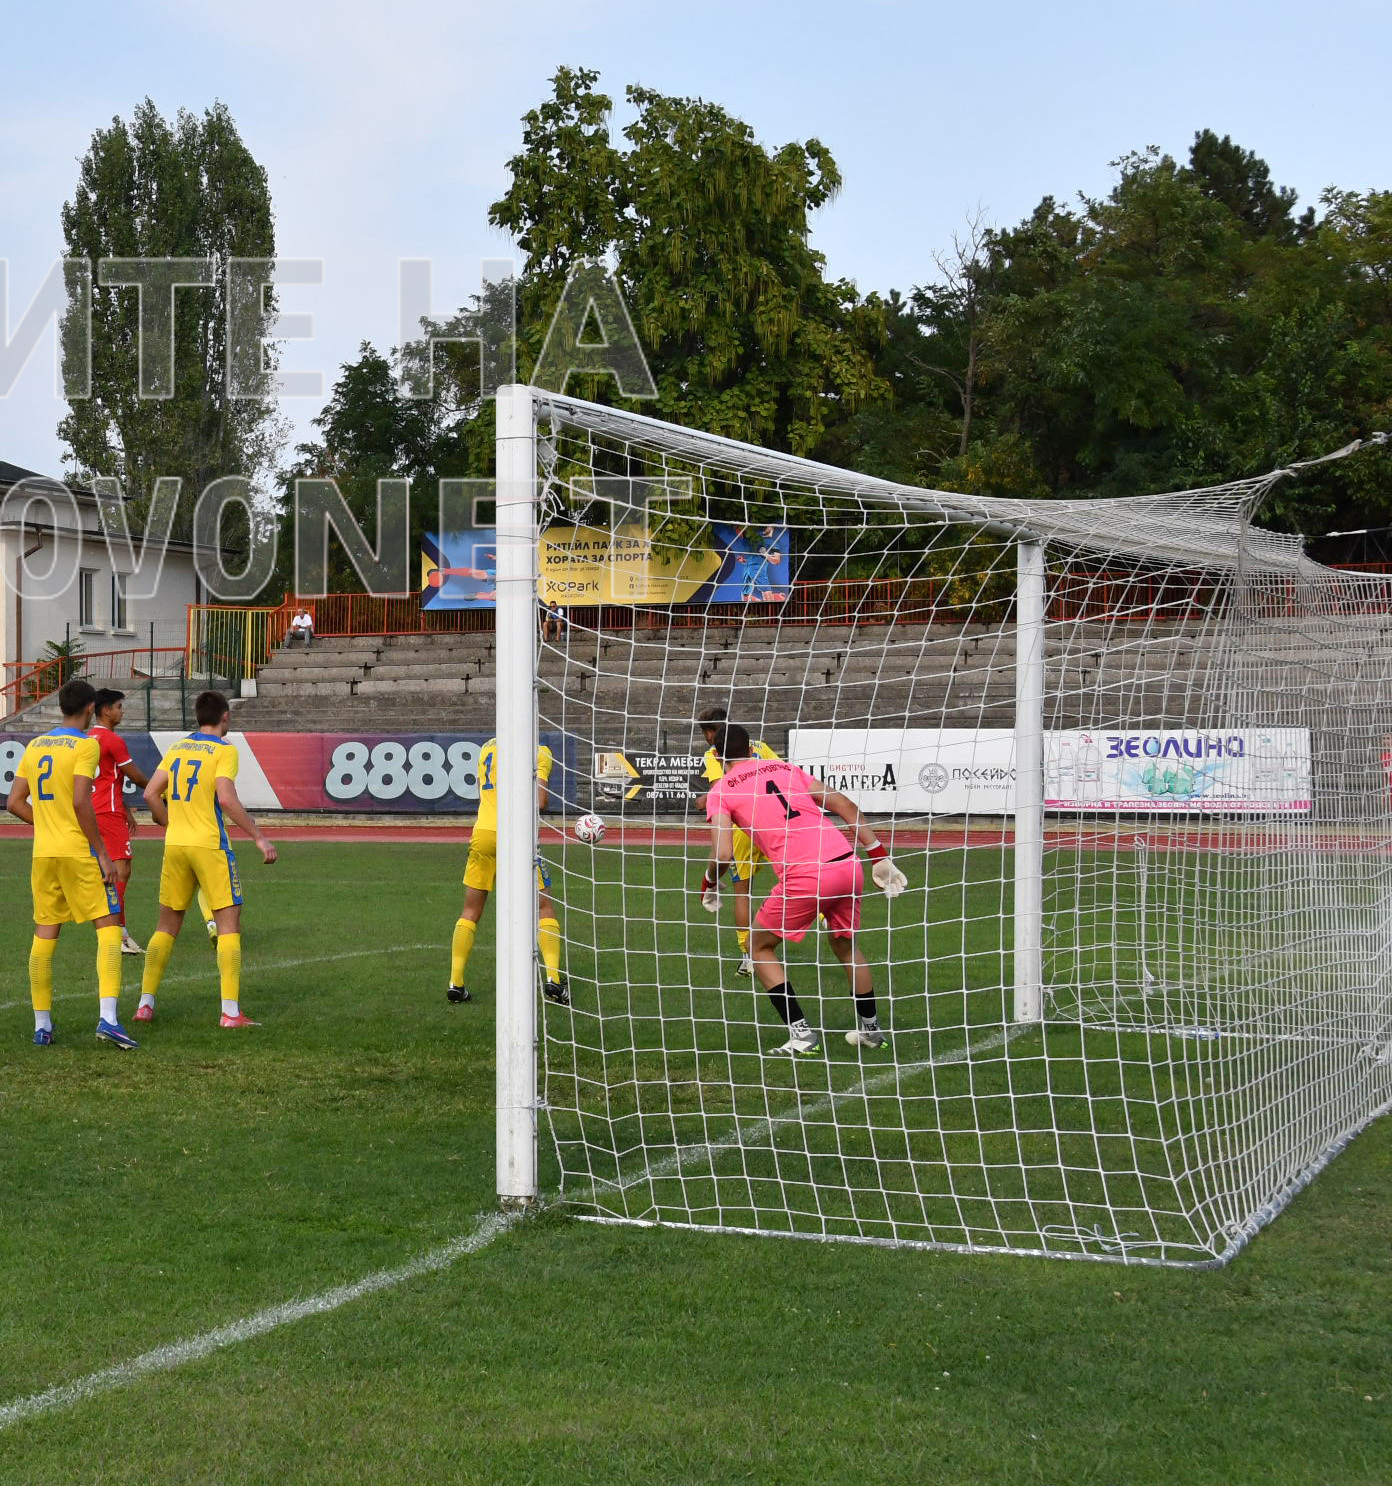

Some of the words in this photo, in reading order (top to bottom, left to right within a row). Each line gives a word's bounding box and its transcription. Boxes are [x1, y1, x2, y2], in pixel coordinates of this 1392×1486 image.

[546, 540, 590, 552] РИТЕЙЛ
[625, 540, 640, 549] ЗА
[546, 554, 589, 565] ХОРАТА
[592, 554, 605, 563] ЗА
[608, 552, 653, 562] СПОРТА
[38, 755, 54, 800] 2
[170, 758, 202, 801] 17
[325, 741, 481, 800] 8888
[482, 752, 495, 791] 1
[829, 764, 866, 772] БИСТРО
[952, 767, 1016, 781] ПОСЕЙДО
[766, 780, 801, 820] 1
